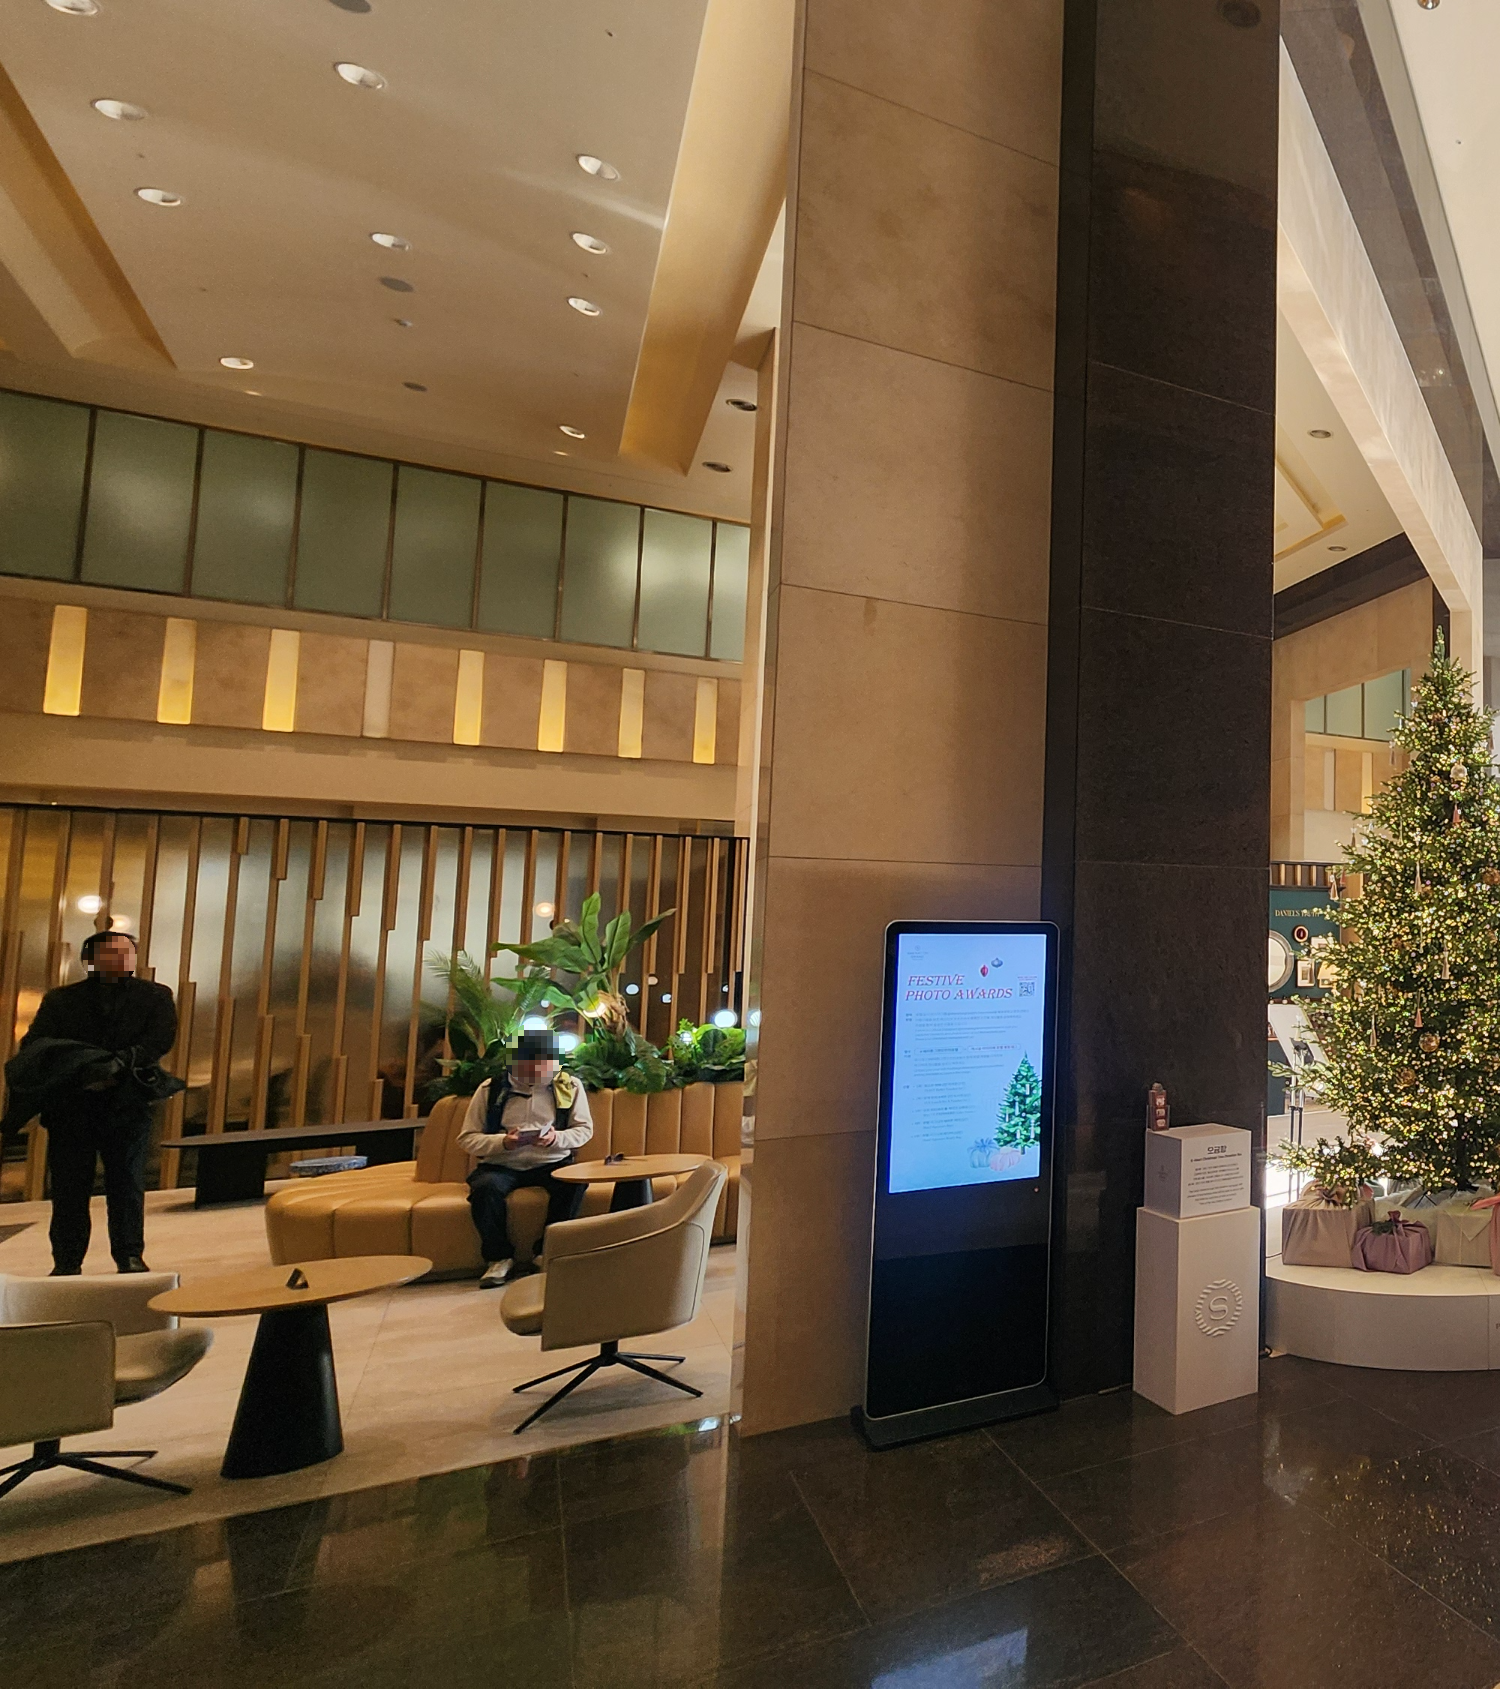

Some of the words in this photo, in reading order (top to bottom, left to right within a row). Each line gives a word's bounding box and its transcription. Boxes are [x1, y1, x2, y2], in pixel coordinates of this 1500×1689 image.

[908, 974, 965, 986] FESTIVE
[905, 989, 951, 1001] PHOTO
[953, 987, 1013, 1000] AWARDS
[1209, 1295, 1228, 1320] S
